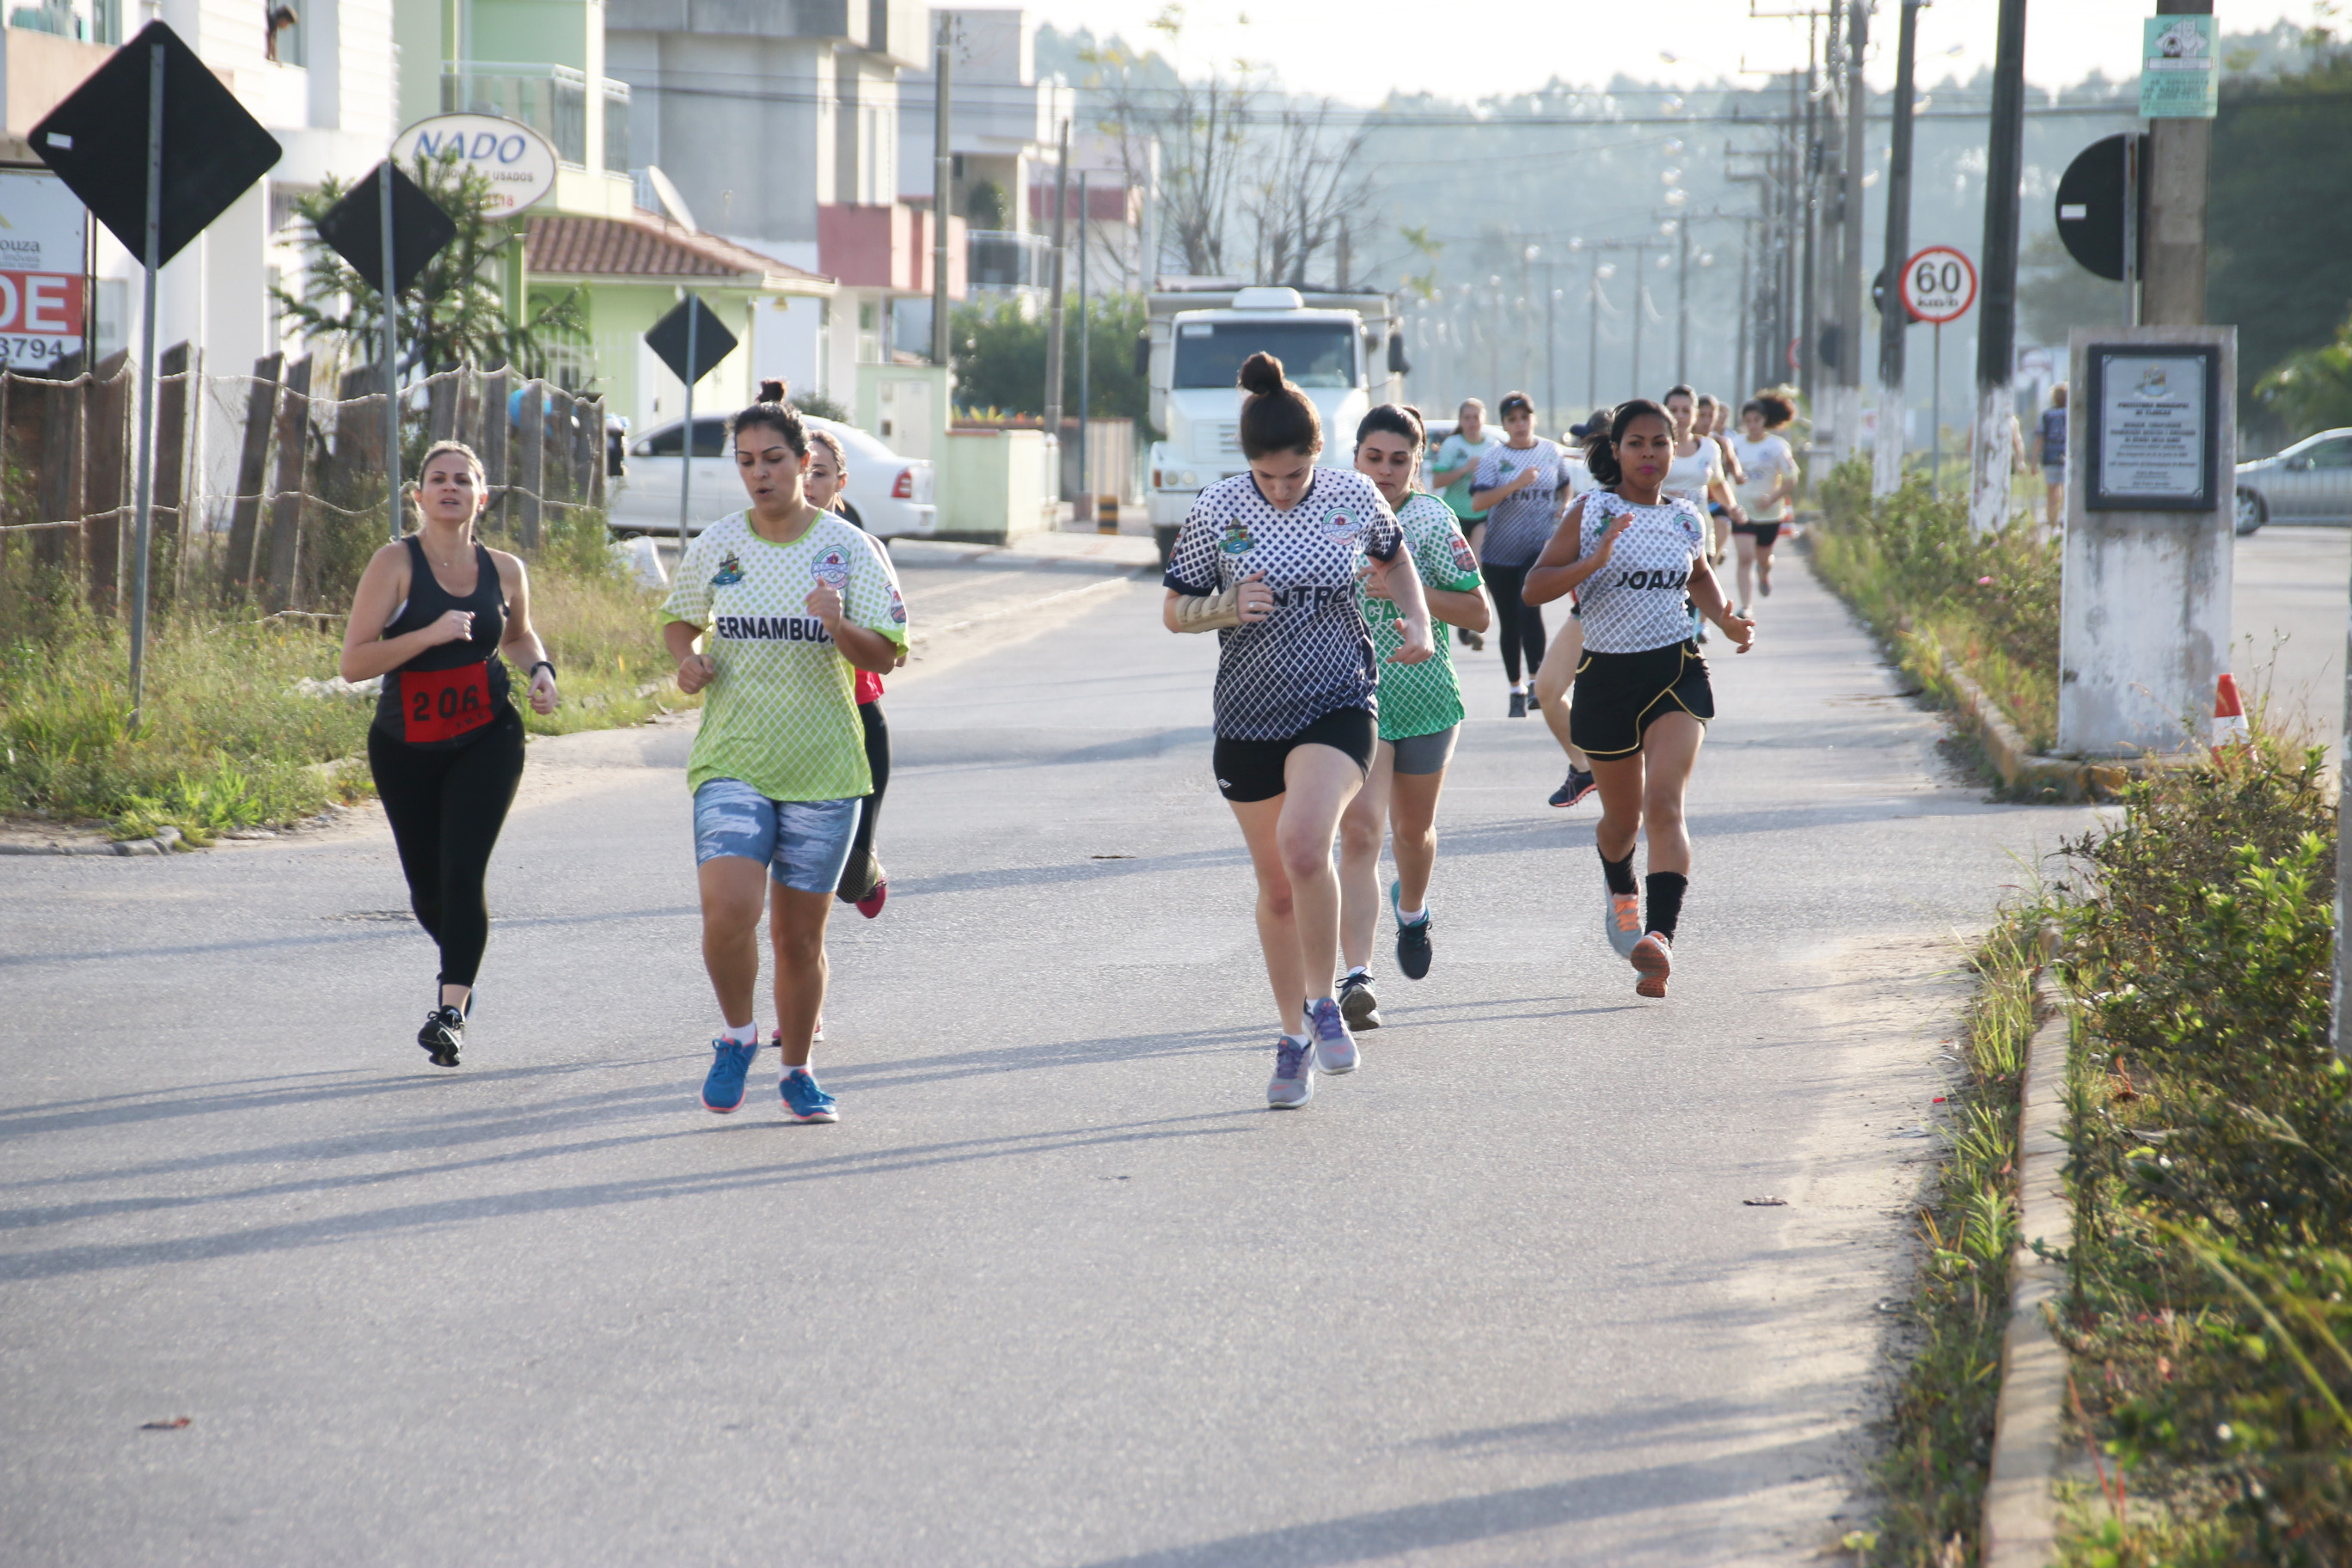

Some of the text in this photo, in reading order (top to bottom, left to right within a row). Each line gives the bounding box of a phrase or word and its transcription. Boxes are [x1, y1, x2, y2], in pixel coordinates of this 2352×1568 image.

[412, 130, 526, 164] NADO
[493, 171, 534, 182] USADOS
[0, 239, 40, 252] ouza
[1916, 260, 1961, 294] 60
[1918, 296, 1959, 307] km/h
[413, 684, 480, 721] 206
